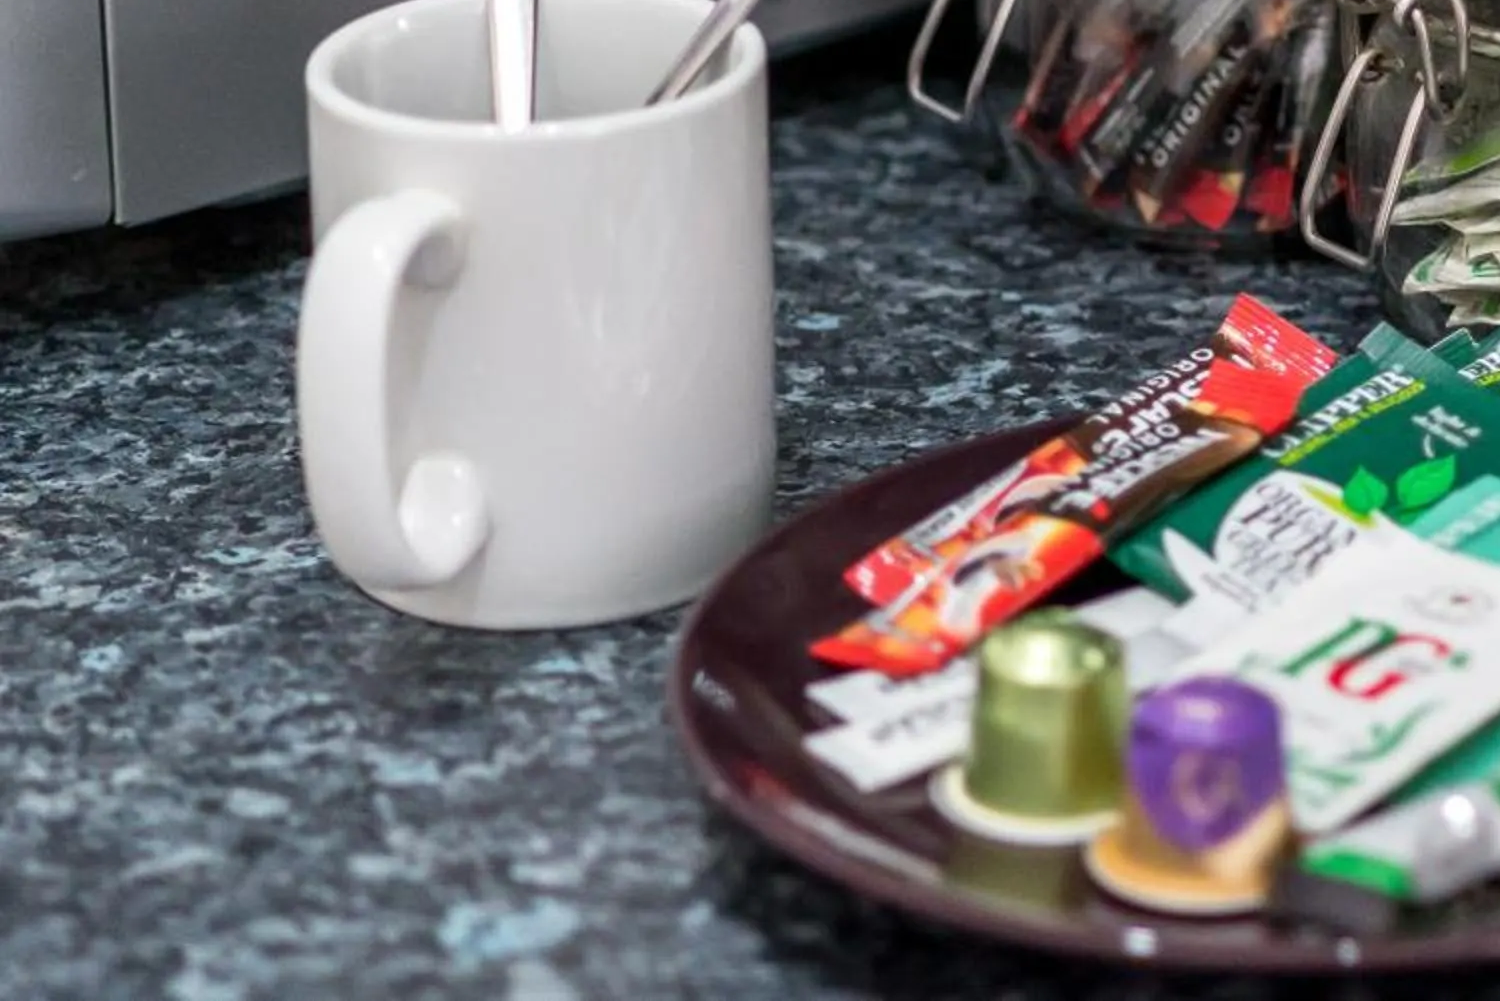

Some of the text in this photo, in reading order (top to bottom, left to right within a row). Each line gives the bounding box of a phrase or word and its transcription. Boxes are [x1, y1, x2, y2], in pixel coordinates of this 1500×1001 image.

[1152, 46, 1248, 168] ORIGINAL
[1085, 347, 1215, 425] ORIGINAL
[1240, 502, 1334, 577] PUR
